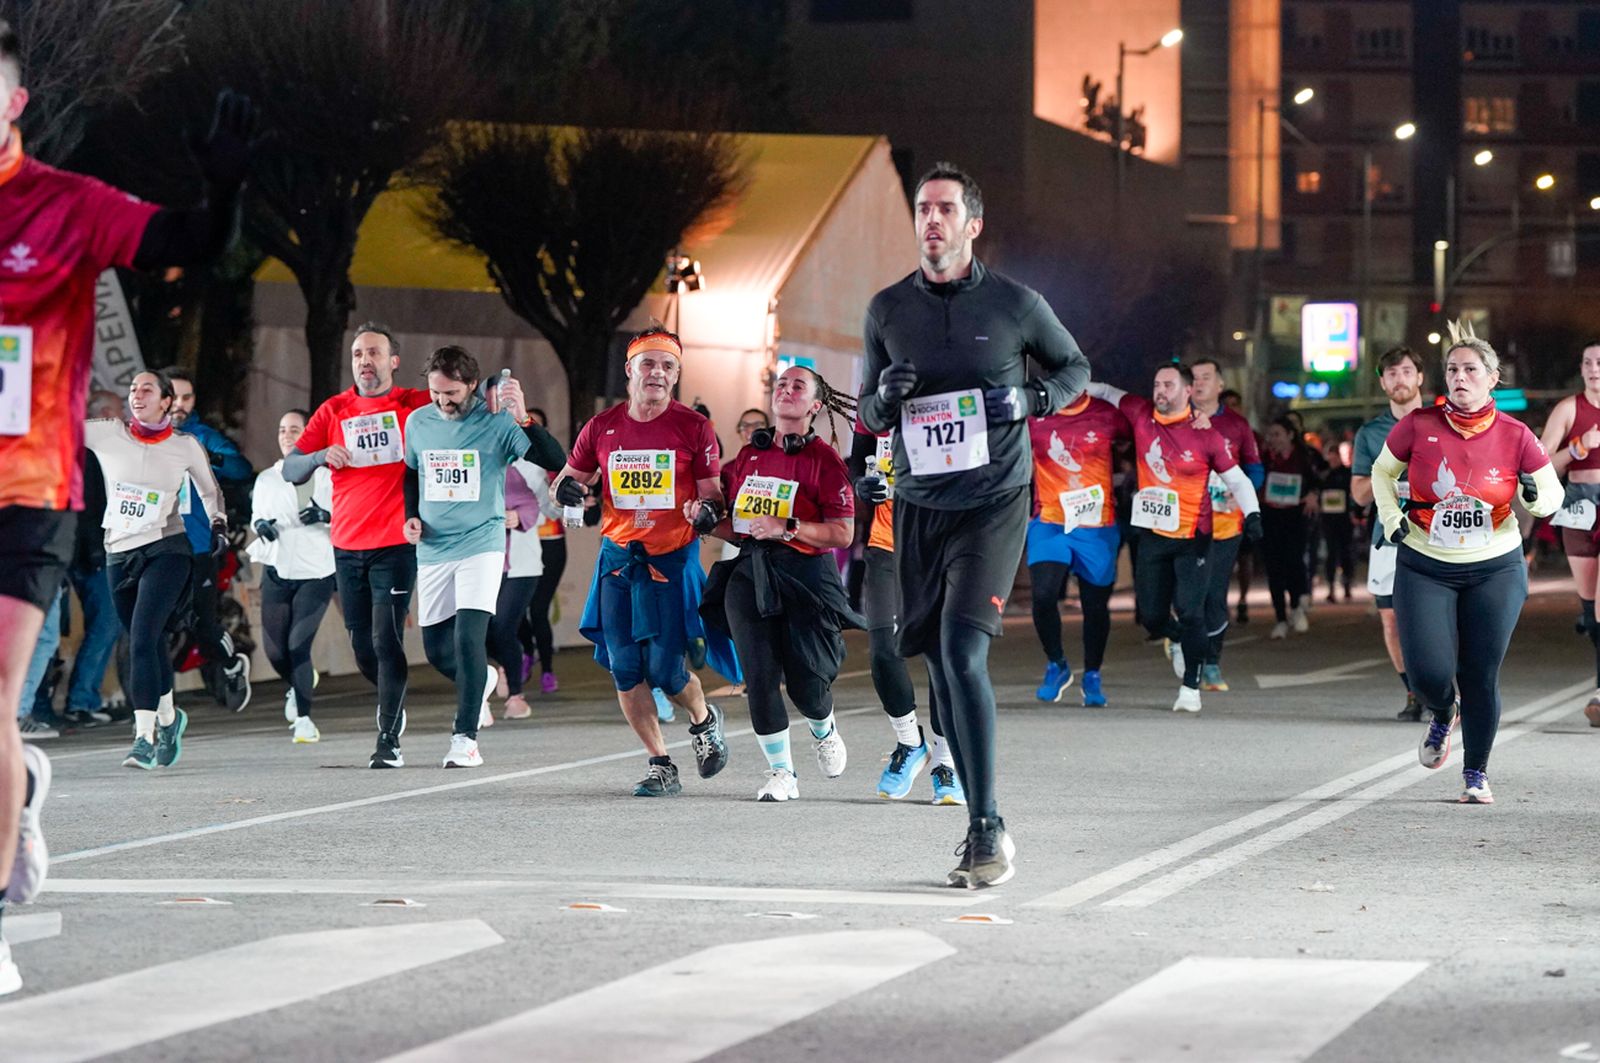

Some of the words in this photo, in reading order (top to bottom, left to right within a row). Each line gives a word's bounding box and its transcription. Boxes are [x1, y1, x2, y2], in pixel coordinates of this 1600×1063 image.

[357, 431, 389, 450] 4179
[923, 421, 965, 447] 7127
[435, 468, 468, 484] 5091
[620, 471, 663, 489] 2892
[120, 500, 146, 518] 650
[743, 495, 780, 518] 2891
[1142, 500, 1172, 517] 5528
[1442, 510, 1483, 529] 5966
